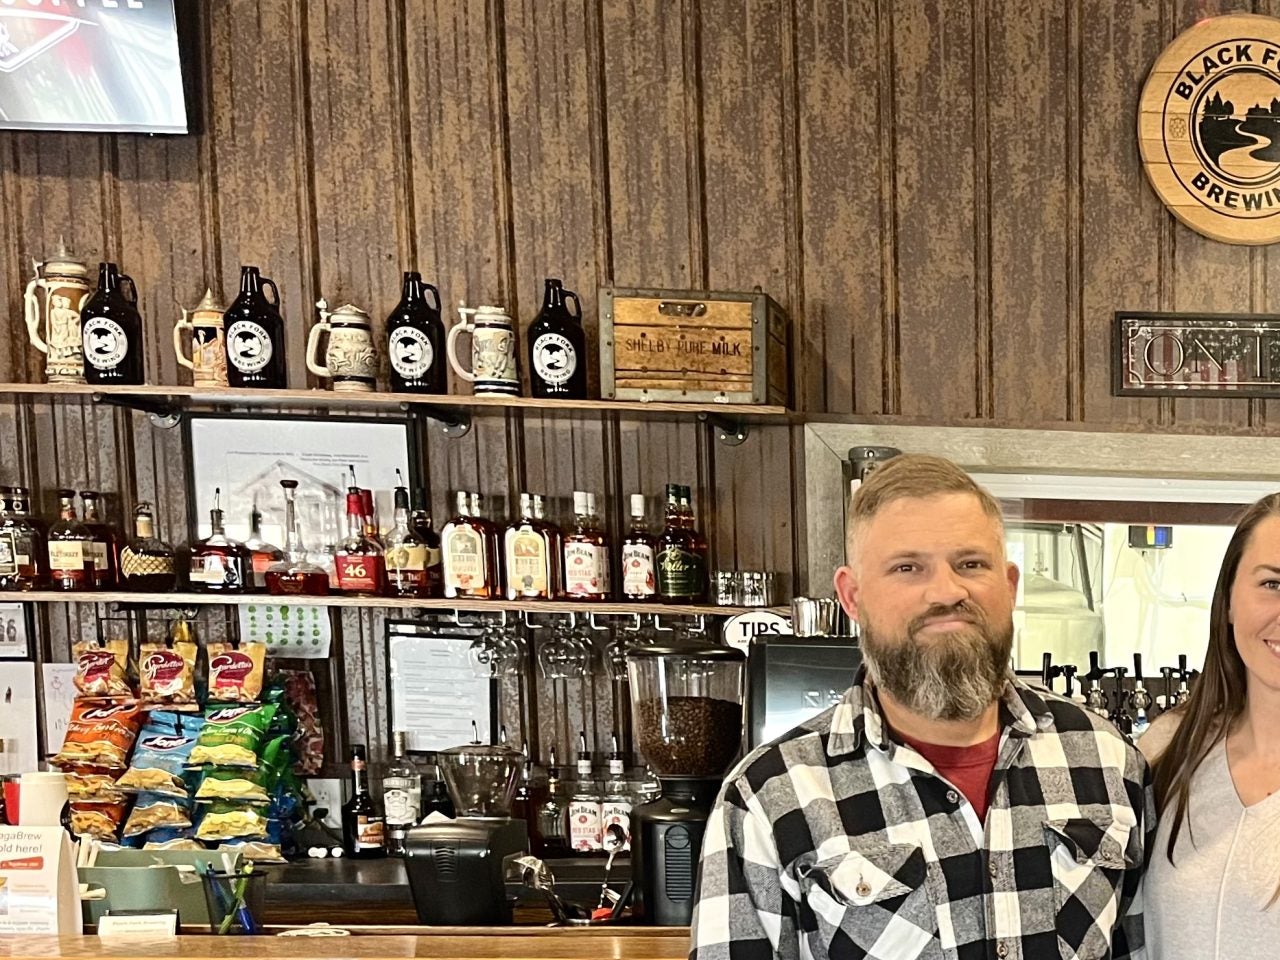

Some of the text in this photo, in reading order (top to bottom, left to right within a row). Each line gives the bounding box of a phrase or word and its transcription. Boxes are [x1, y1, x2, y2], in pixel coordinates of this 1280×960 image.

[1175, 45, 1253, 101] BLACK
[625, 338, 671, 353] SHELBY
[712, 342, 741, 357] MILK
[1143, 332, 1225, 377] ON
[739, 621, 780, 637] TIPS
[15, 844, 42, 853] here!
